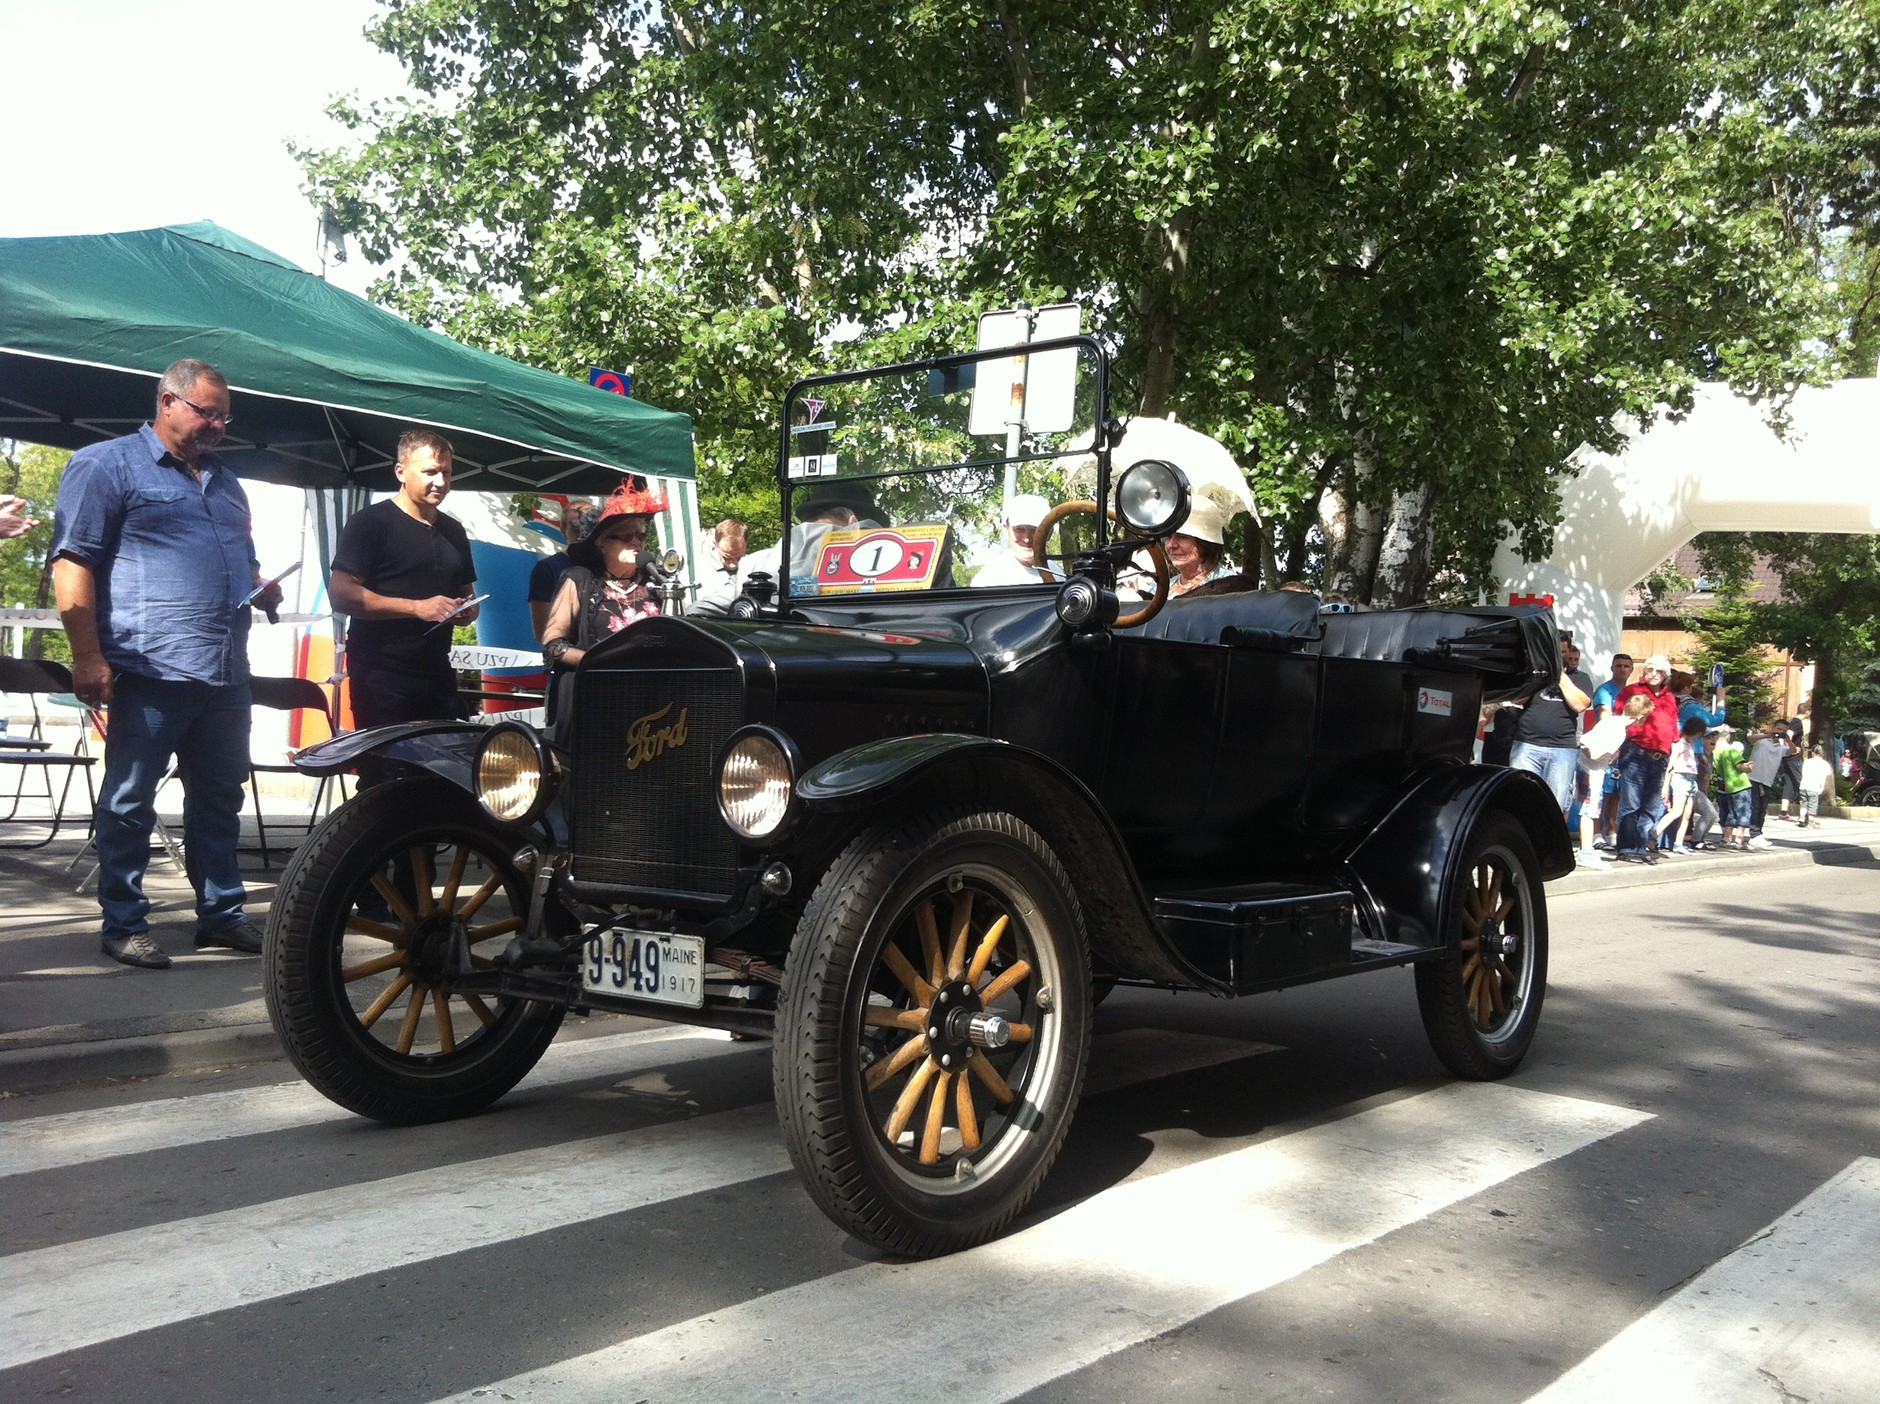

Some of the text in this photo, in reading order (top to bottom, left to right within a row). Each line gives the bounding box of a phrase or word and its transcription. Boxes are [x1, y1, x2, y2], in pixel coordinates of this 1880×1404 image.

[868, 546, 883, 572] 1
[1430, 696, 1450, 708] TOTAL
[625, 701, 688, 771] Ford
[588, 935, 660, 994] 9-949
[662, 946, 698, 966] MAINE
[662, 974, 697, 993] 1917
